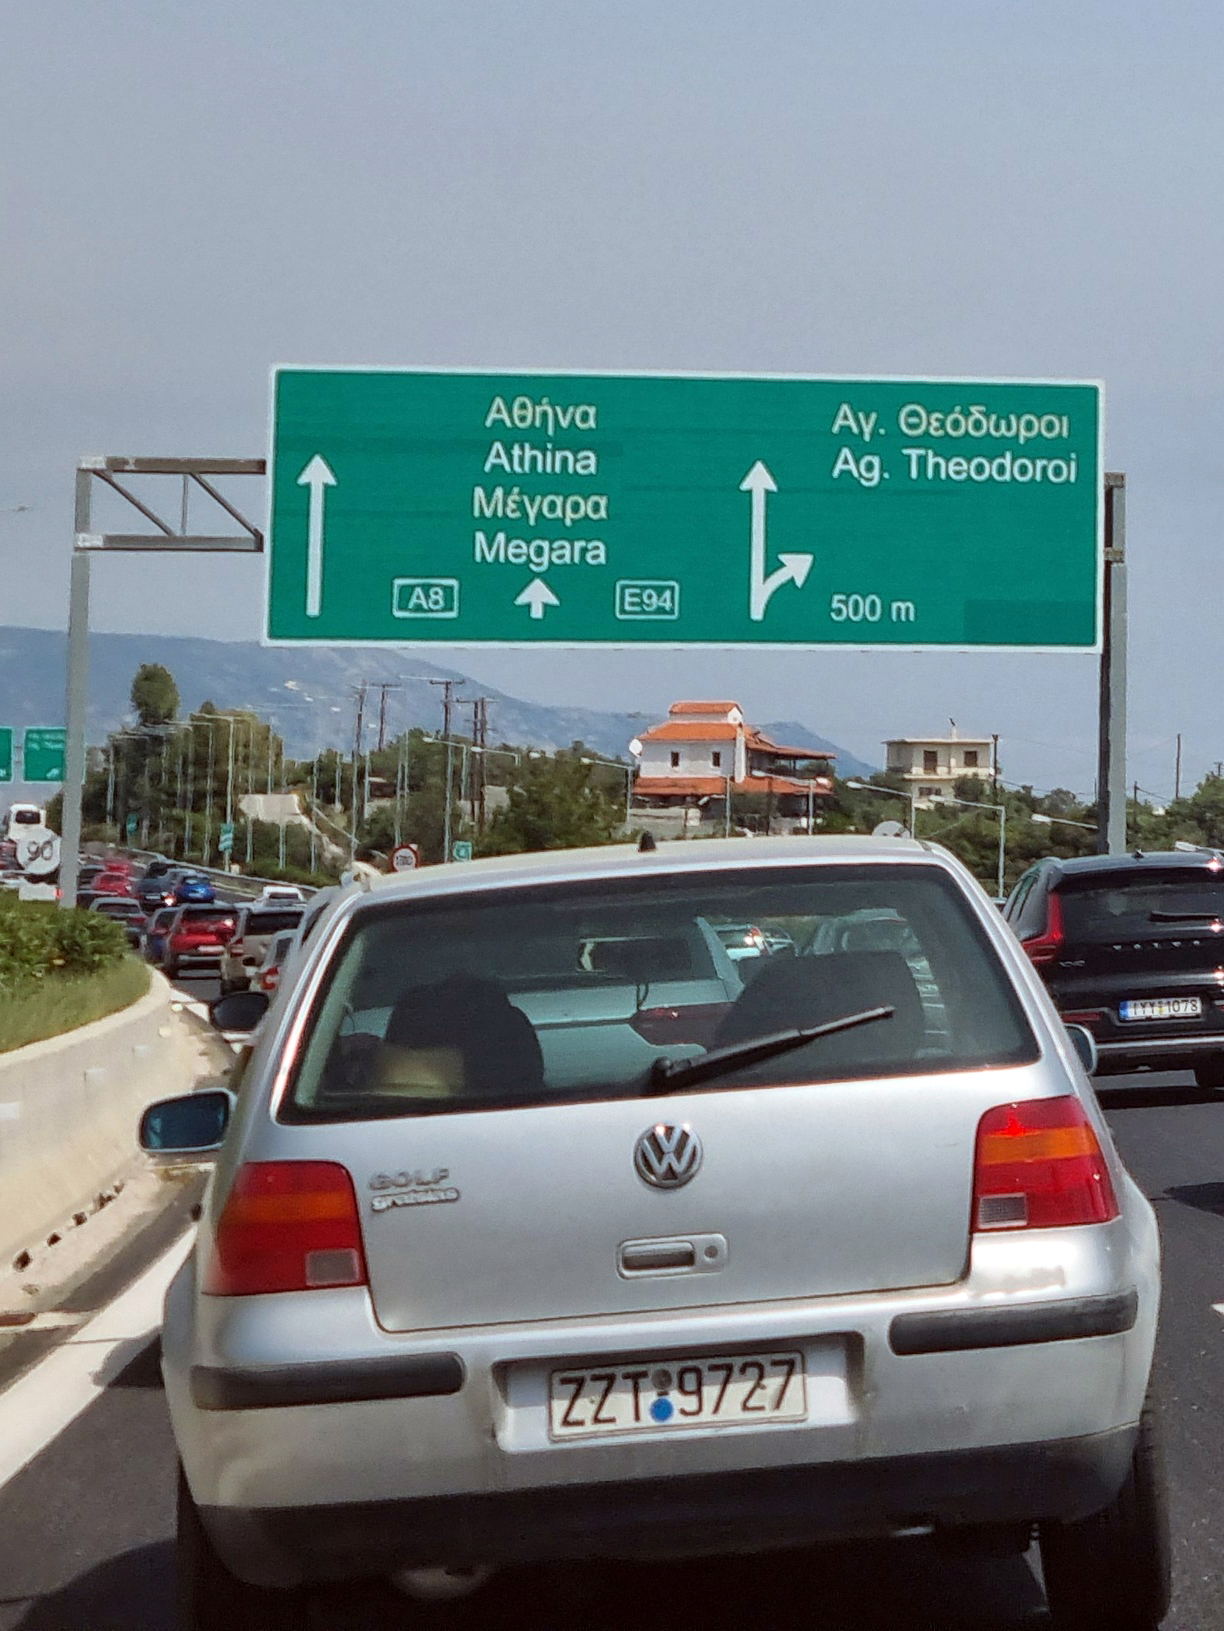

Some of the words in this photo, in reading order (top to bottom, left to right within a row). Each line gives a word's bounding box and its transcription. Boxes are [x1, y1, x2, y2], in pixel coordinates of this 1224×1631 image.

[485, 396, 598, 436] Αθήνα
[831, 402, 886, 442] Αγ.
[899, 403, 1070, 445] Θεόδωροι
[484, 442, 598, 475] Athina
[832, 447, 890, 487] Ag.
[902, 447, 1078, 483] Theodoroi
[473, 486, 608, 526] Μέγαρα
[474, 531, 607, 572] Megara
[407, 585, 446, 610] A8
[624, 587, 673, 612] E94
[830, 594, 882, 622] 500
[890, 599, 916, 622] m
[27, 840, 53, 861] 90
